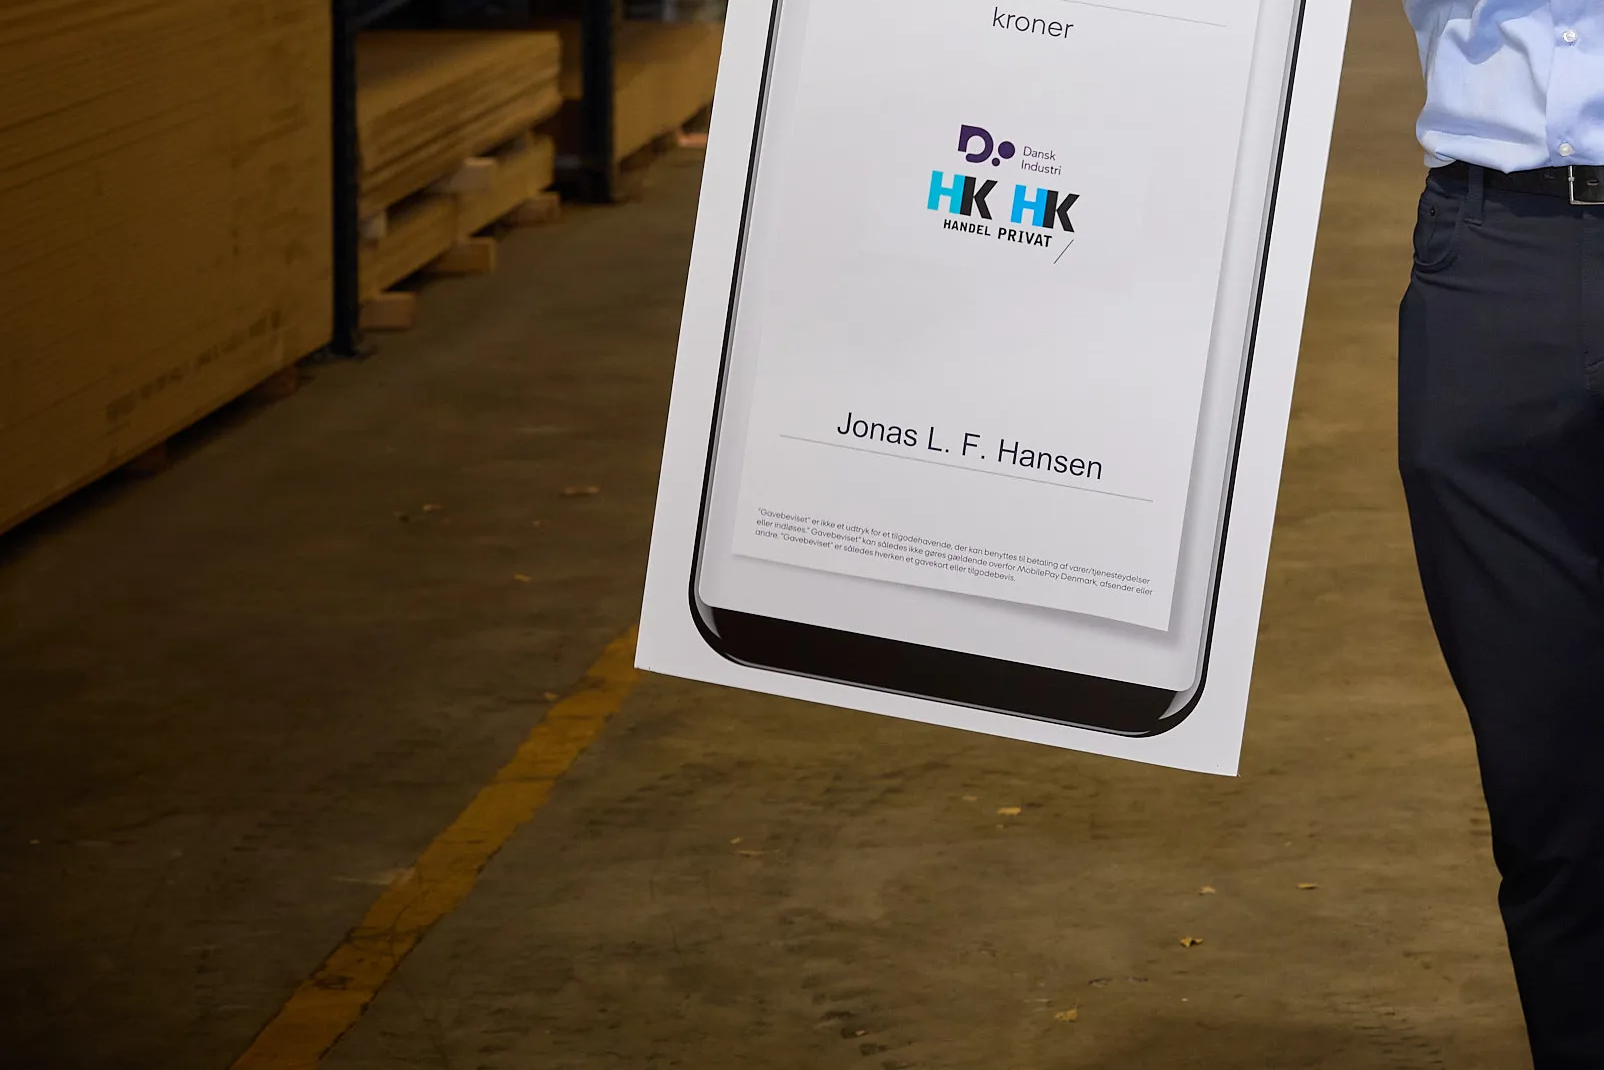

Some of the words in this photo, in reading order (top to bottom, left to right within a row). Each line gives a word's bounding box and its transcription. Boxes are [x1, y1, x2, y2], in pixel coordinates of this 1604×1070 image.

[992, 6, 1074, 39] kroner
[1021, 159, 1062, 176] Industri
[1023, 146, 1056, 161] Dansk
[927, 170, 998, 220] HK
[1010, 184, 1081, 233] HK
[943, 219, 991, 237] HANDEL
[997, 227, 1053, 248] PRIVAT
[837, 412, 918, 447] Jonas
[927, 427, 950, 453] L.
[962, 433, 985, 459] F.
[998, 439, 1103, 480] Hansen
[756, 519, 773, 528] eller
[862, 537, 876, 546] kan
[877, 540, 907, 551] således
[908, 546, 924, 555] ikke
[924, 549, 946, 559] gøres
[947, 553, 988, 566] gældende
[988, 561, 1016, 571] overfor
[1016, 565, 1059, 580] MobilePay
[1060, 572, 1098, 586] Denmark,
[1100, 580, 1135, 592] afsender
[1136, 587, 1153, 596] eller
[811, 518, 820, 526] er
[820, 518, 836, 529] ikke
[836, 523, 845, 531] et
[845, 524, 870, 535] udtryk
[871, 528, 881, 537] for
[891, 532, 953, 550] tilgodehavende,
[954, 544, 968, 552] der
[968, 546, 983, 555] kan
[984, 548, 1018, 562] benyttes
[1026, 557, 1059, 570] betaling
[1059, 562, 1068, 570] af
[1069, 565, 1150, 585] varer/tjenesteydelser
[843, 544, 874, 556] således
[874, 551, 904, 562] hverken
[914, 557, 948, 570] gavekort
[949, 564, 967, 573] eller
[967, 567, 1016, 582] tilgodebevis.
